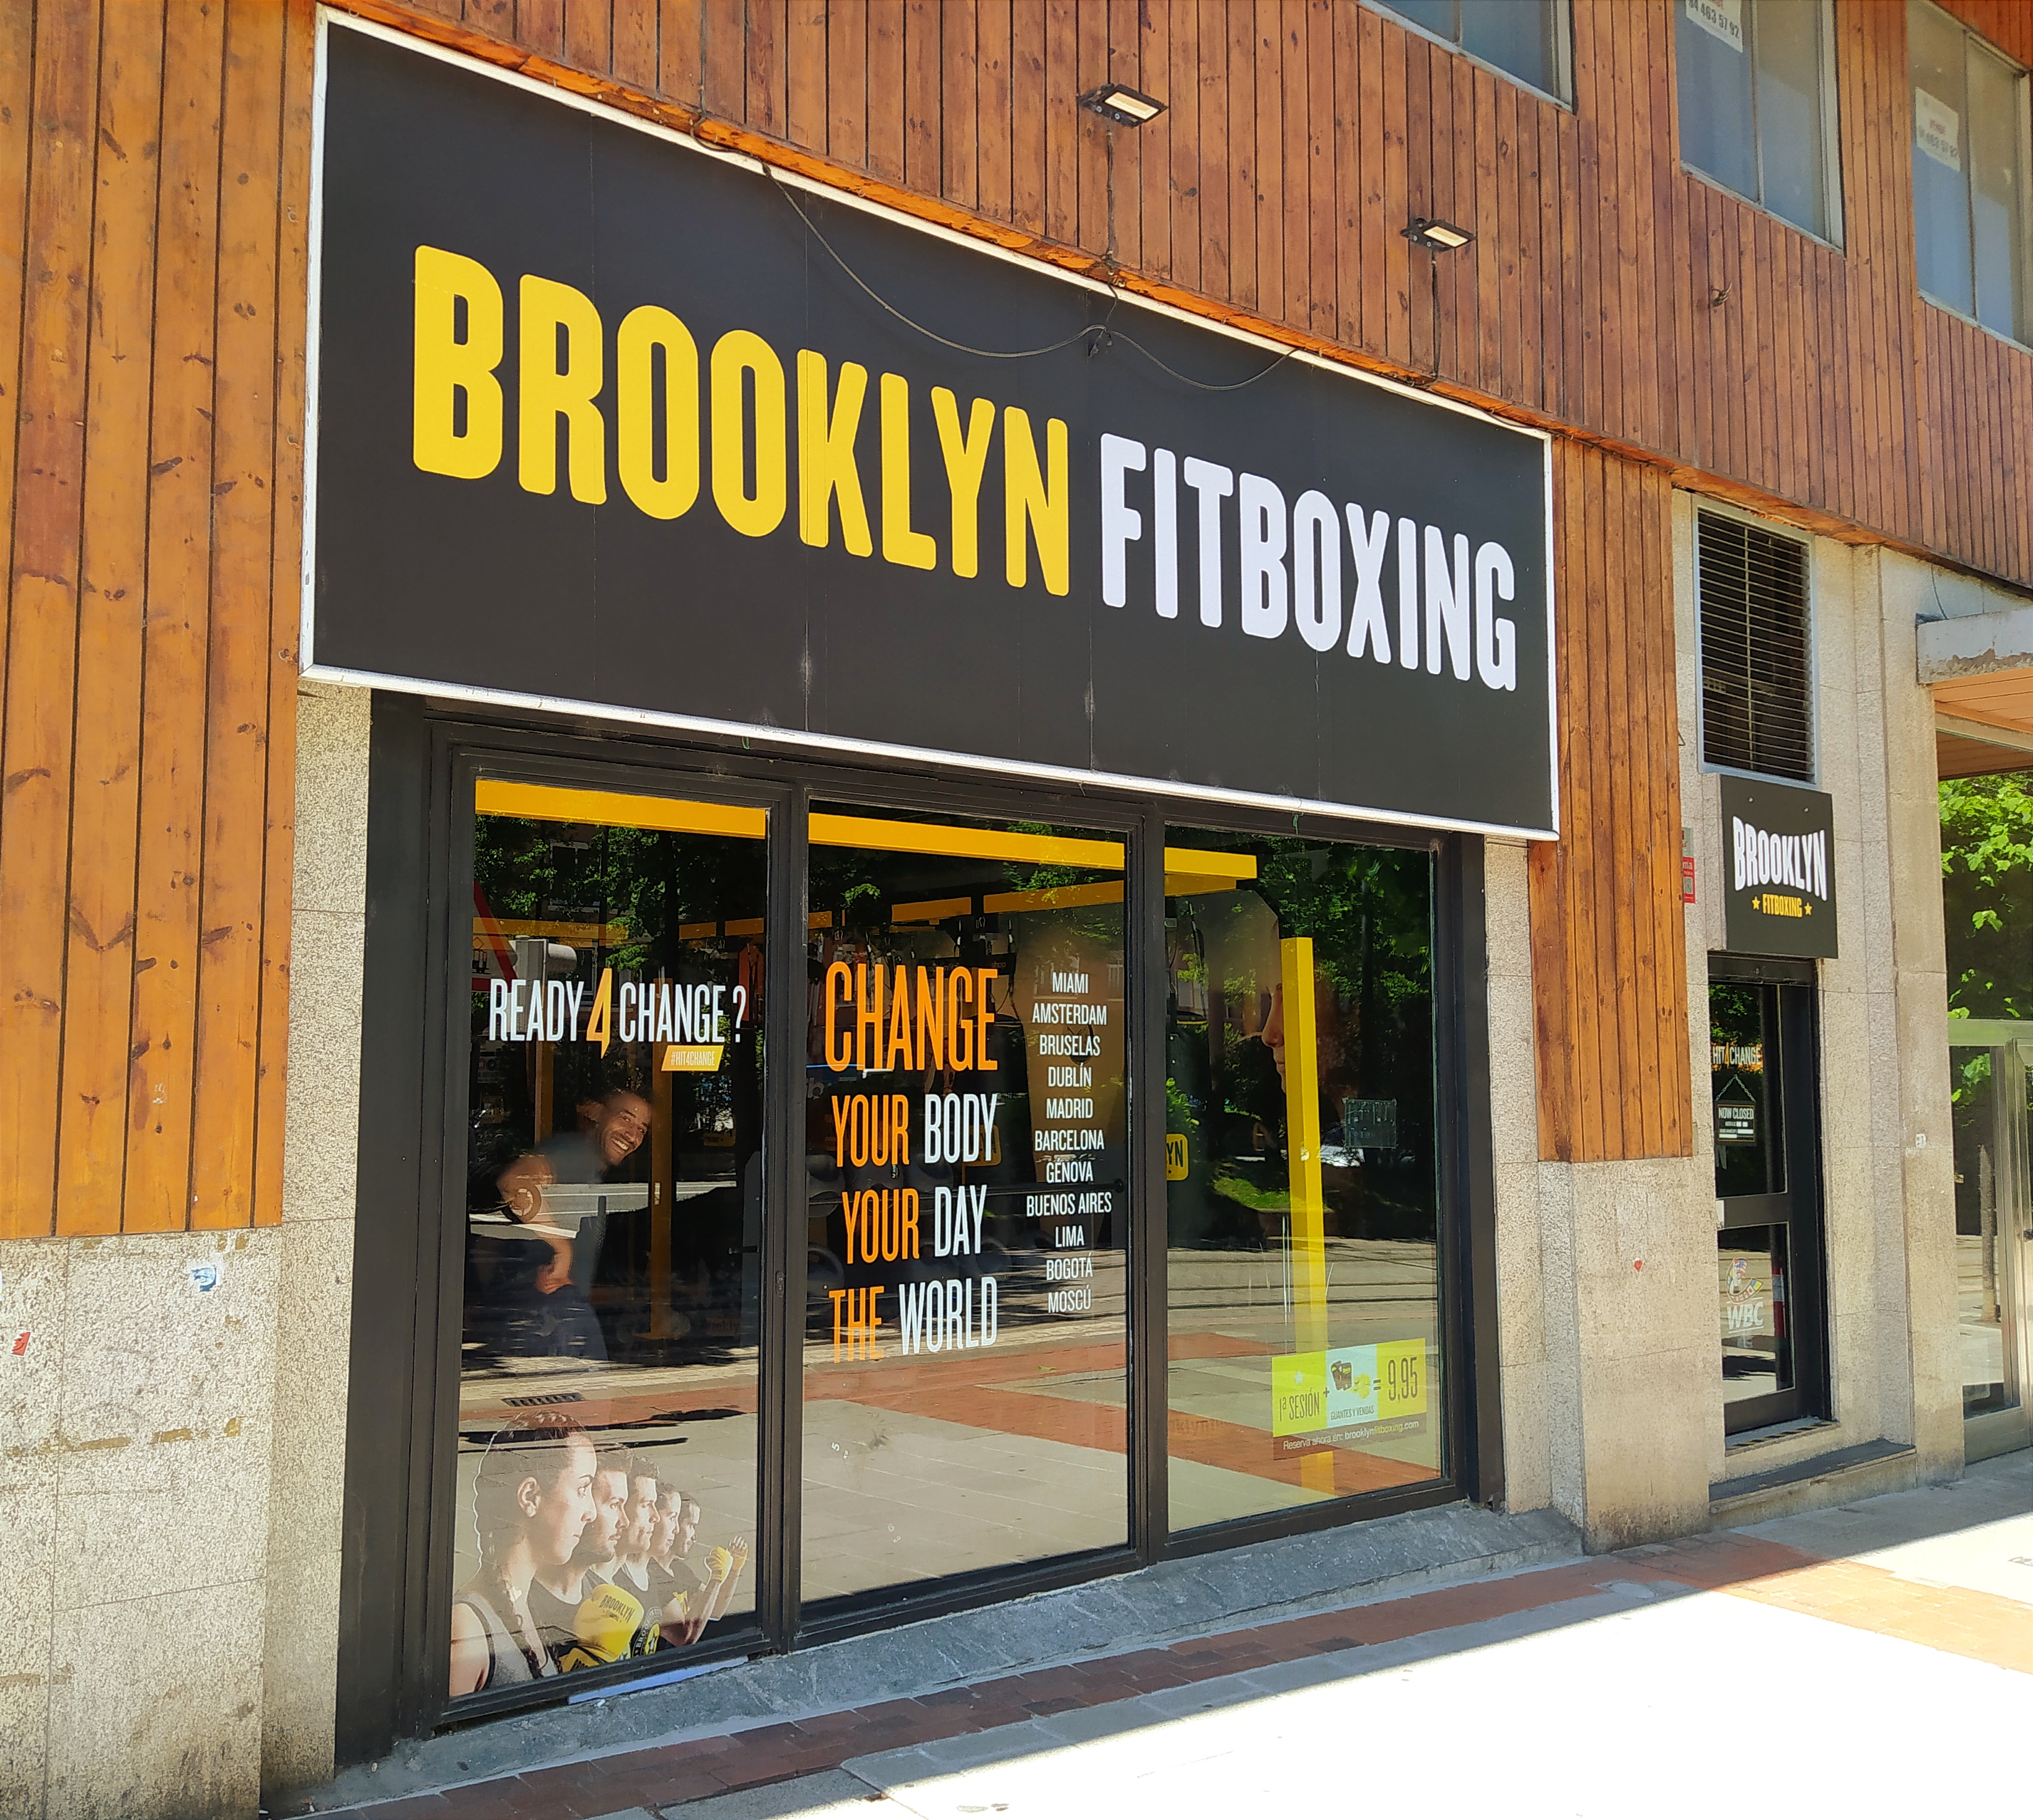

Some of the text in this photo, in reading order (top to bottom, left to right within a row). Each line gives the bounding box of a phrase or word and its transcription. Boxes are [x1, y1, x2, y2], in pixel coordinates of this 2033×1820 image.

[413, 245, 1516, 691] BROOKLYN FITBOXING
[1732, 816, 1827, 901] BROOKLYN
[1762, 893, 1802, 917] FITBOXING
[1052, 972, 1089, 994] MIAMI
[489, 978, 584, 1042] READY
[586, 968, 613, 1059] 4
[619, 982, 726, 1043] CHANGE
[825, 961, 998, 1072] CHANGE
[1032, 1002, 1107, 1025] AMSTERDAM
[670, 1051, 716, 1065] #HIT4CHANGE
[1039, 1035, 1100, 1056] BRUSELAS
[1048, 1062, 1092, 1087] DUBLÍN
[1046, 1098, 1093, 1119] MADRID
[1718, 1107, 1754, 1119] NOW CLOSED
[832, 1093, 998, 1168] YOUR BODY
[1035, 1129, 1105, 1151] BARCELONA
[1046, 1158, 1094, 1183] GÉNOVA
[1026, 1192, 1112, 1217] BUENOS AIRES
[841, 1184, 987, 1264] YOUR DAY
[1055, 1225, 1085, 1248] LIMA
[1046, 1252, 1093, 1281] BOGOTÁ
[1048, 1285, 1091, 1313] MOSCÚ
[828, 1276, 998, 1363] THE WORLD
[1726, 1302, 1763, 1330] WBC
[1289, 1388, 1320, 1420] SESIÓN
[1387, 1357, 1418, 1403] 9,95
[1330, 1408, 1352, 1420] GUANTES
[1356, 1405, 1374, 1416] VENDAS
[1283, 1438, 1311, 1450] Reserva
[1312, 1435, 1332, 1446] ahora
[1345, 1421, 1419, 1440] brooklynfitboxing.com
[599, 1594, 635, 1624] BROOKLYN
